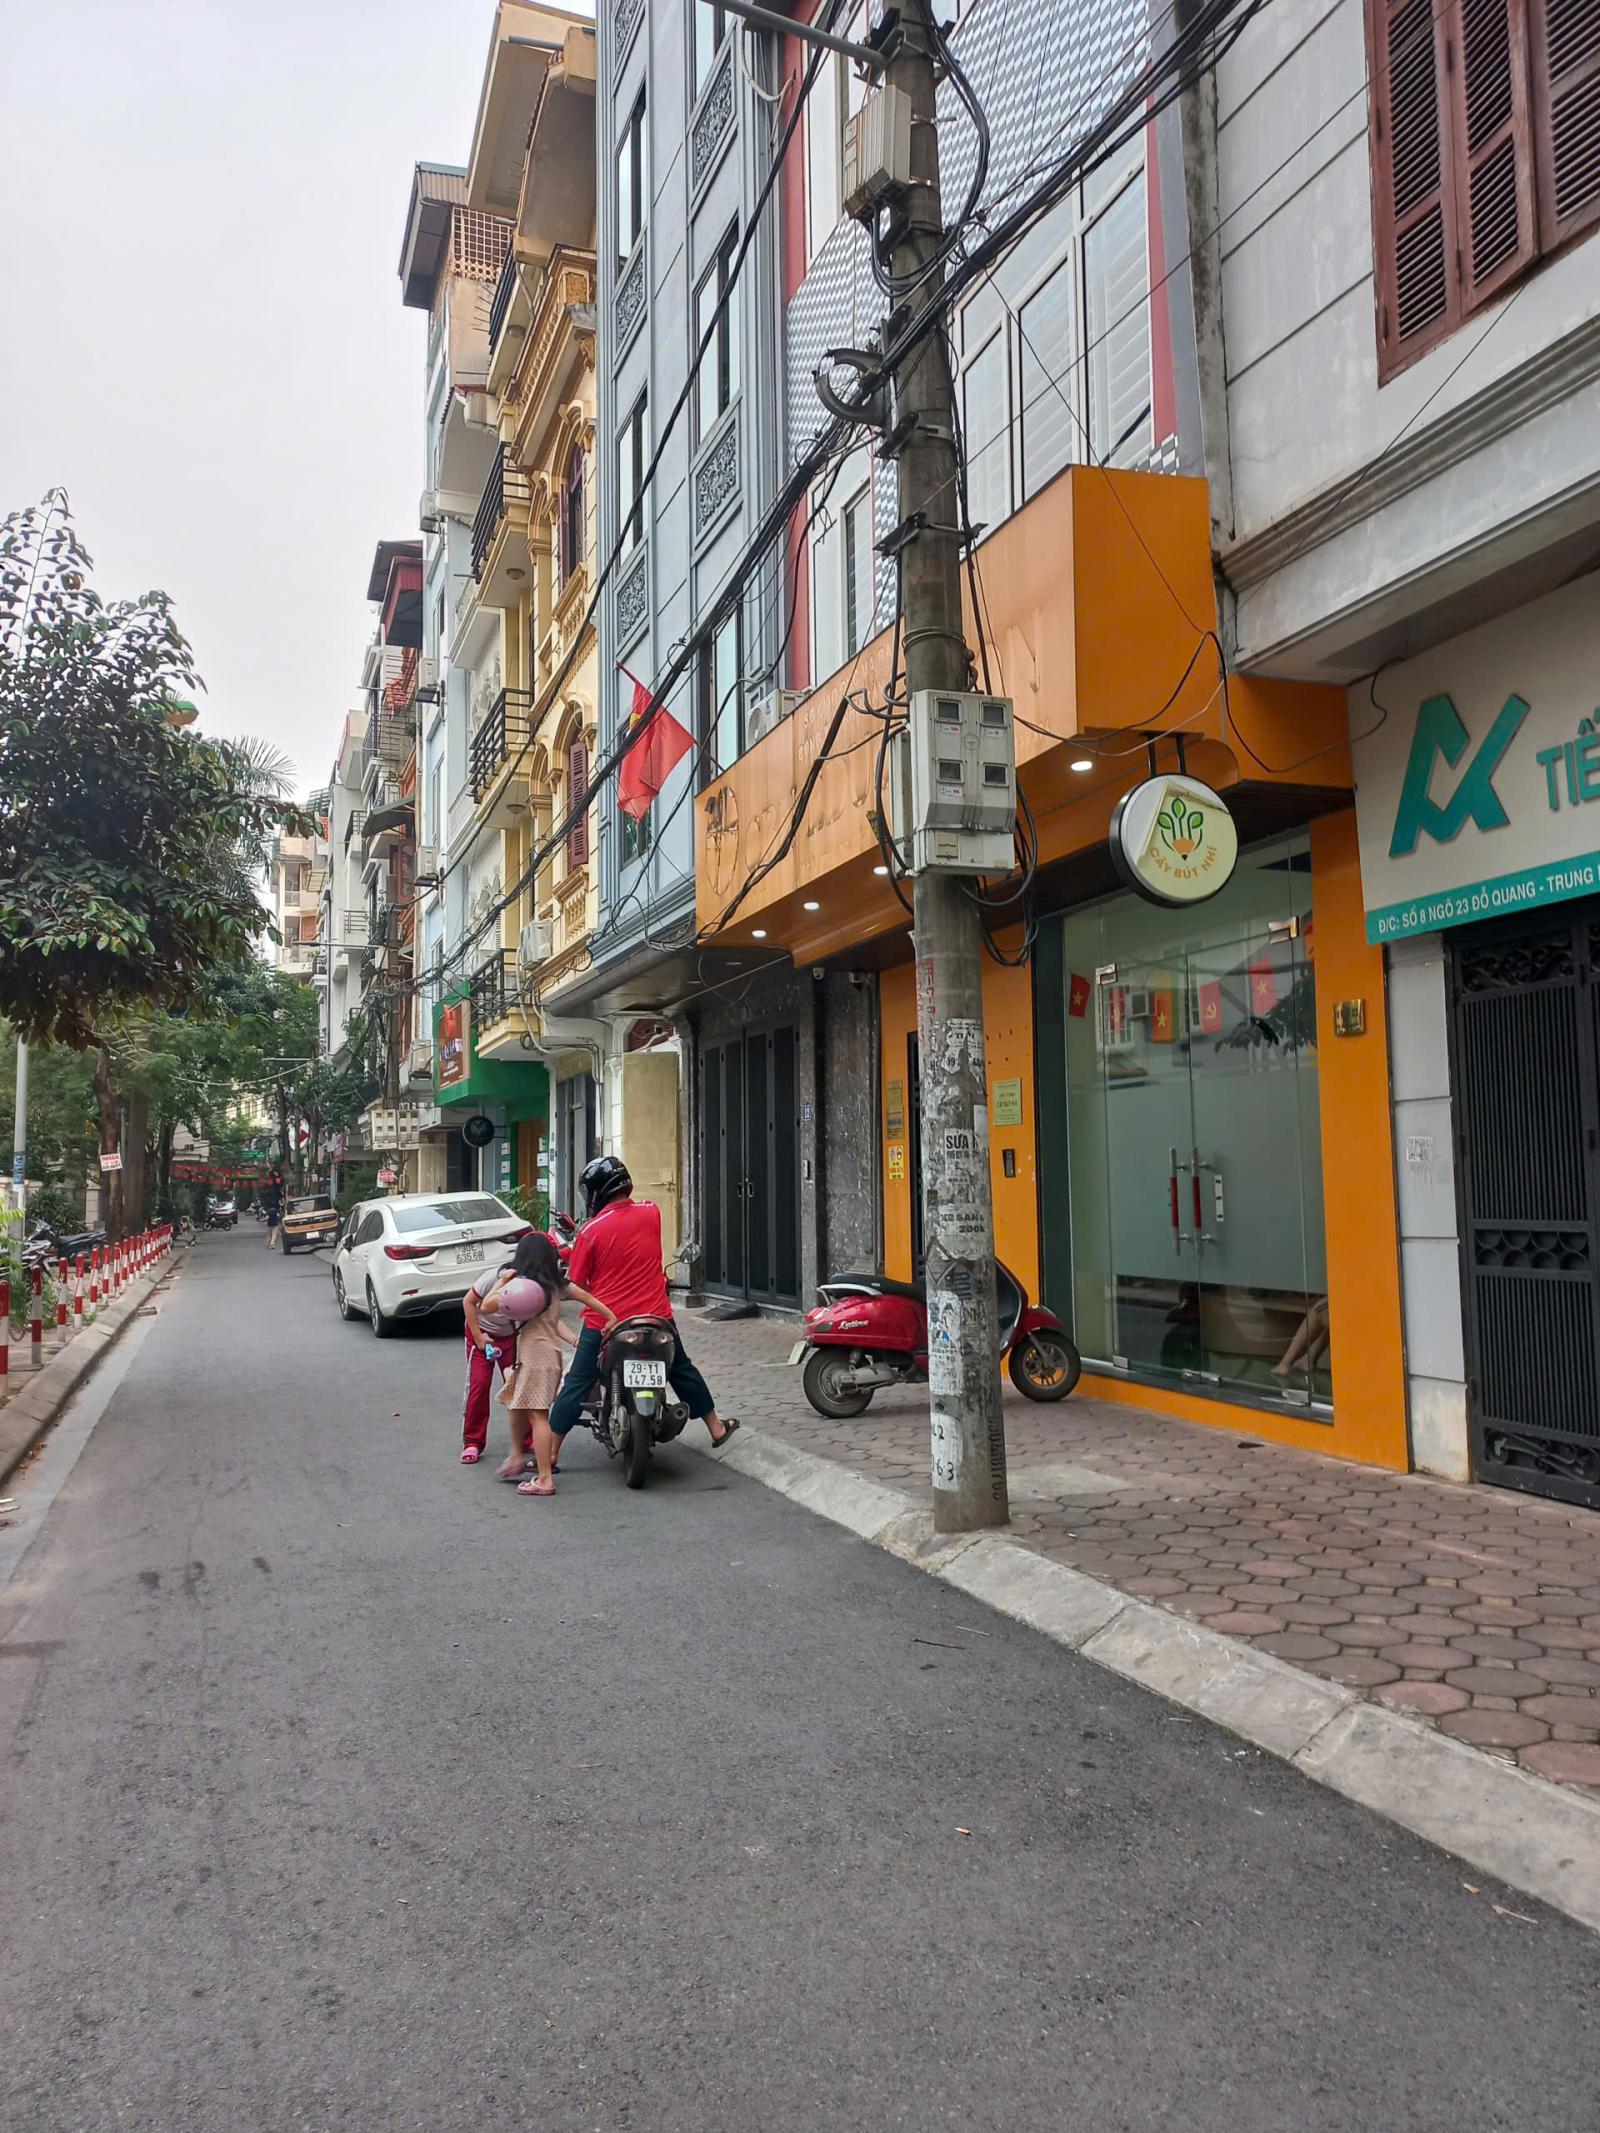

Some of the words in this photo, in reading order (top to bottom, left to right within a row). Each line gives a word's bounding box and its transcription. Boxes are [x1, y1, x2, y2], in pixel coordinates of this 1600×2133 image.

[1402, 904, 1417, 928] SỐ
[1419, 909, 1426, 924] 8
[1456, 898, 1469, 916] 23
[1492, 881, 1536, 906] QUANG
[1546, 867, 1594, 893] TRUNG
[628, 1374, 663, 1386] 147.58
